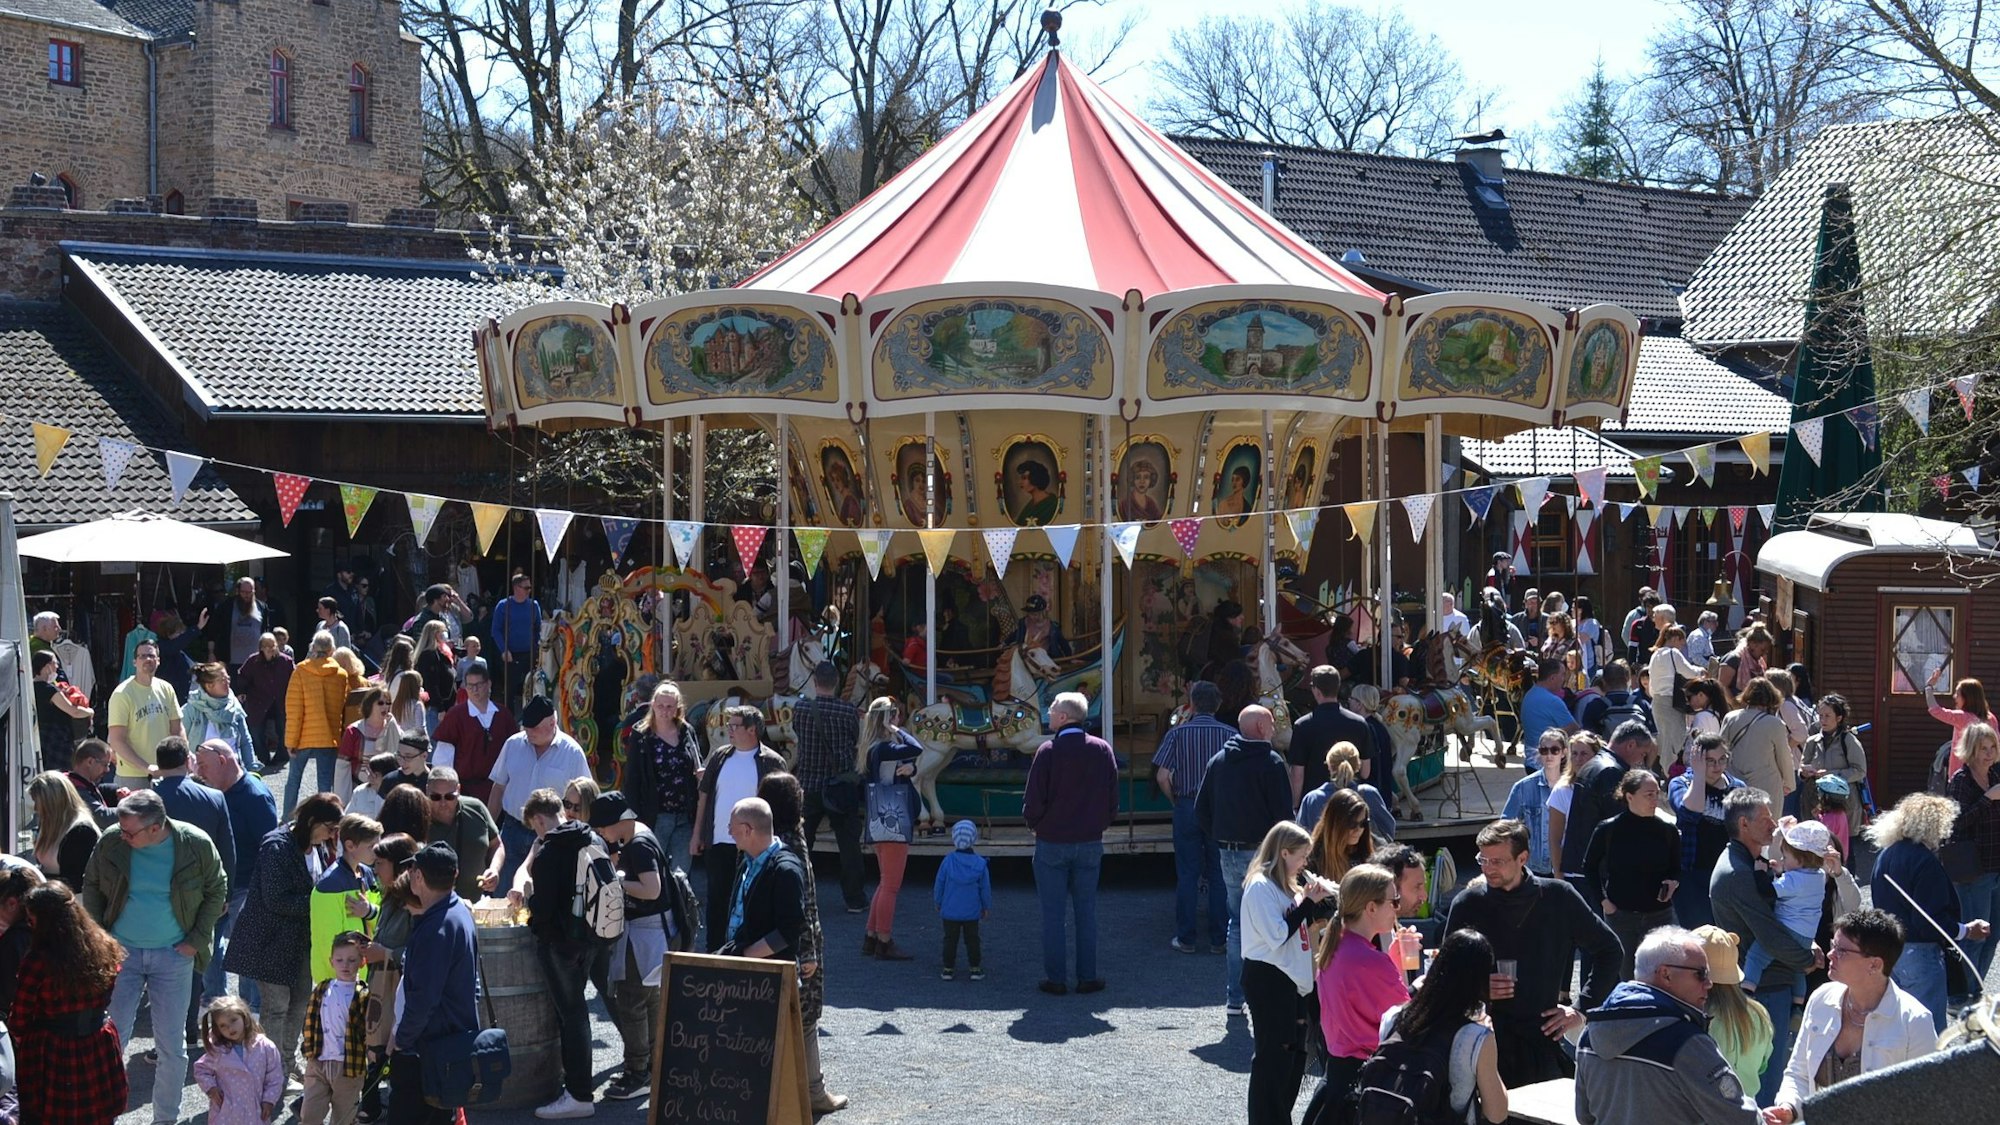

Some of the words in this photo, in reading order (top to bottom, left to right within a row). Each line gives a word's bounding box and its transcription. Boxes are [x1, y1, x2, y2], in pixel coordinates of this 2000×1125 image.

[682, 975, 776, 1005] Senfmühle
[698, 1001, 738, 1022] der
[671, 1021, 710, 1062] Burg
[710, 1068, 753, 1101] Essig
